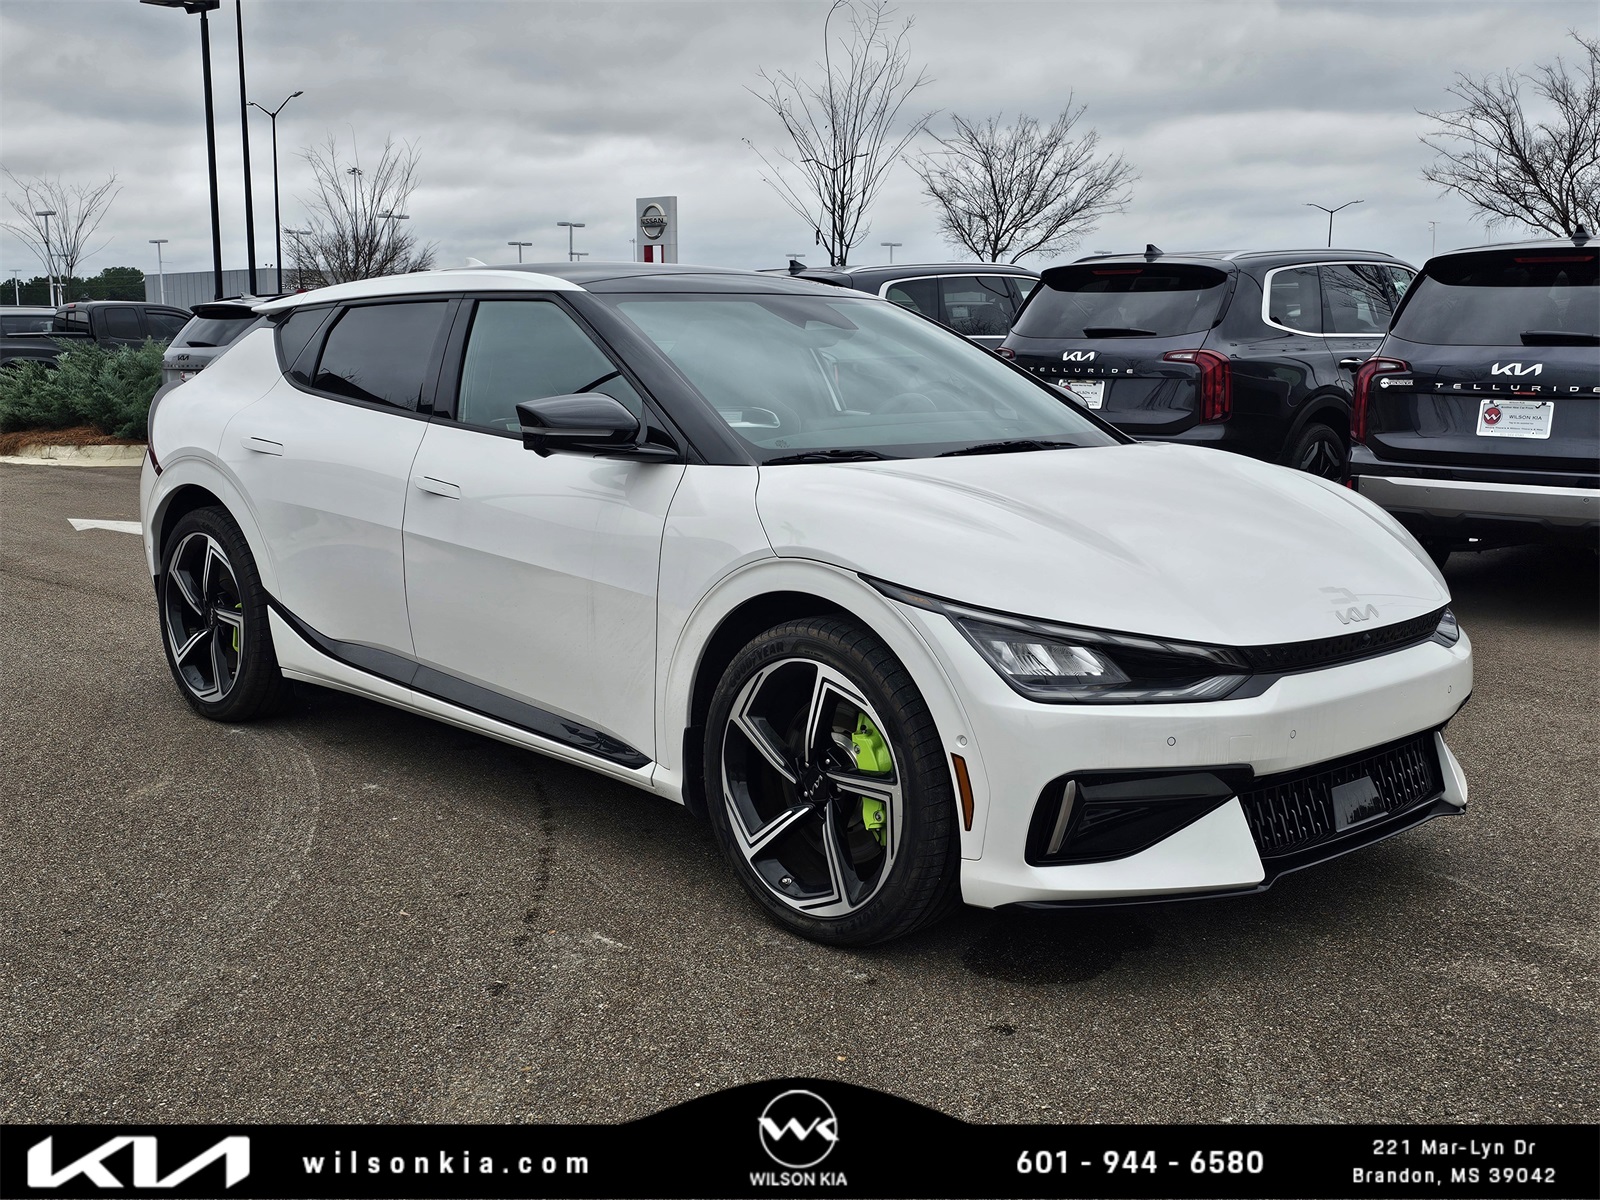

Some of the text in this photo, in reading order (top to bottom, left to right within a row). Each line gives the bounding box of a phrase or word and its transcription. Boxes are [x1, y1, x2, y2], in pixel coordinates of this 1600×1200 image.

[641, 217, 664, 225] NISSAN
[1062, 351, 1096, 361] KIA
[1029, 366, 1134, 374] TELLURIDE
[1491, 362, 1543, 377] KIA
[1434, 382, 1600, 393] TELLURIDE
[1335, 604, 1380, 625] KIA
[728, 641, 785, 688] GOODYEAR
